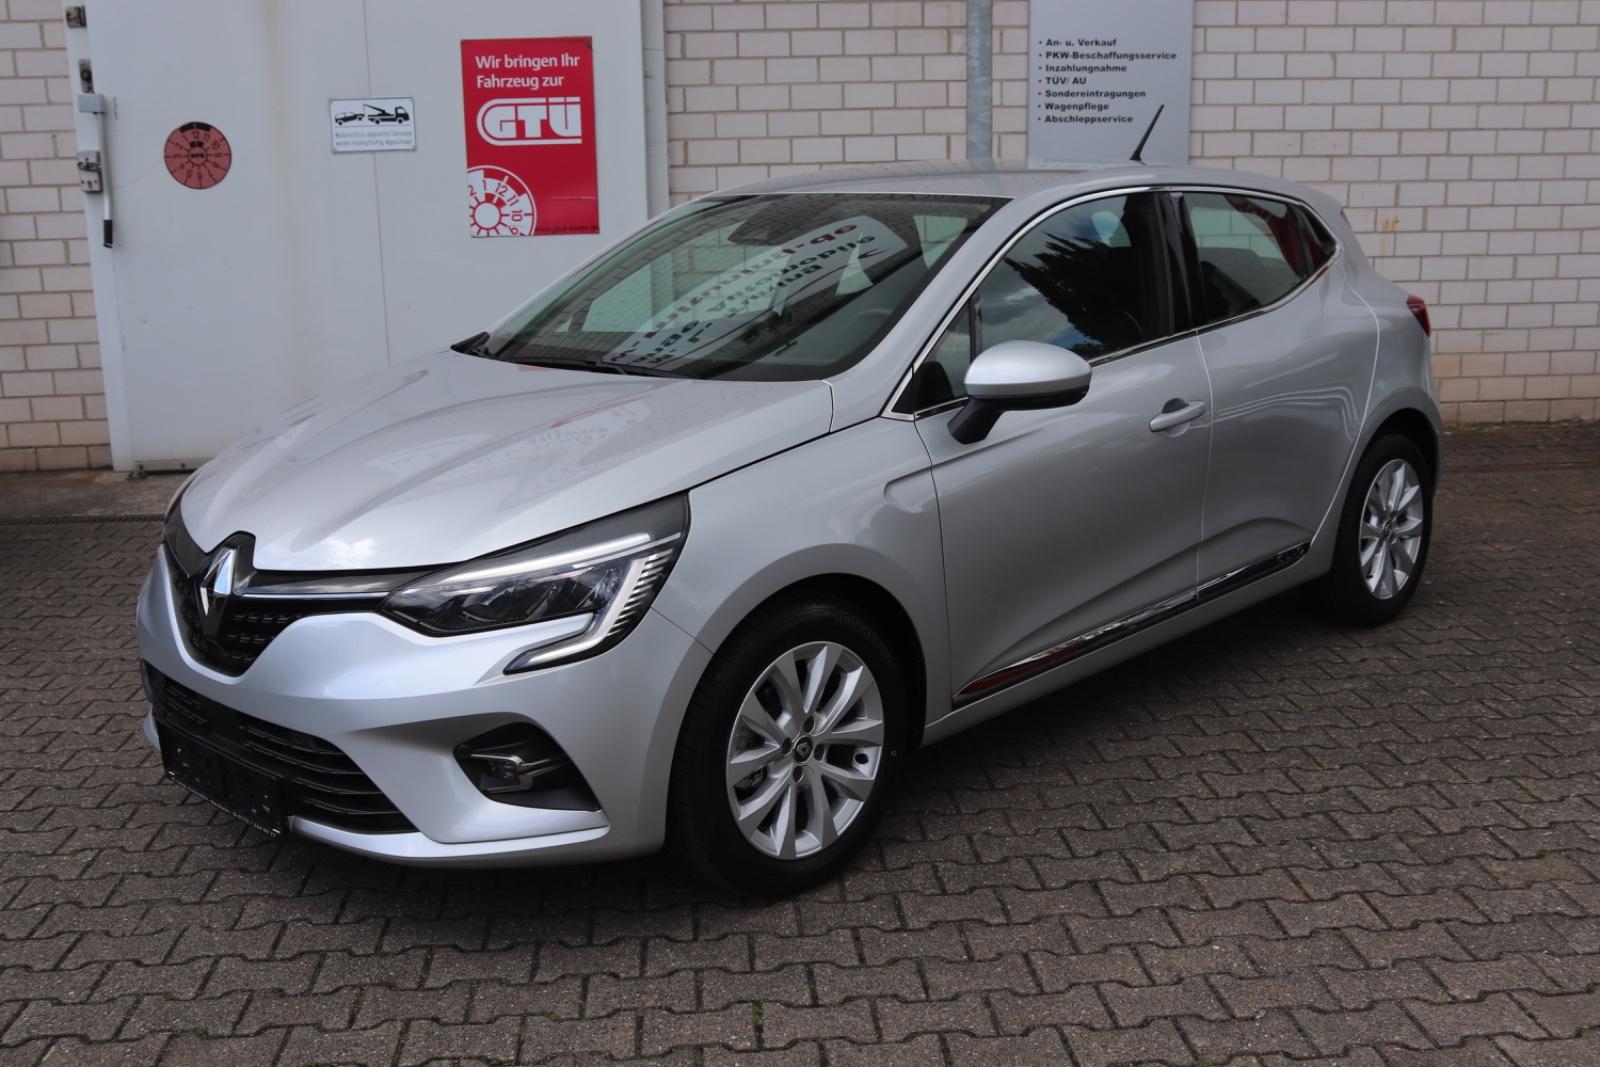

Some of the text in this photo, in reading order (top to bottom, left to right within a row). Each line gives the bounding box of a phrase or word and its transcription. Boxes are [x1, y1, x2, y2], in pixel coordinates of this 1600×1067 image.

[1046, 39, 1063, 47] An-
[1077, 38, 1117, 47] Verkauf
[1045, 51, 1177, 61] PKW-Beschaffungsservice
[475, 53, 580, 71] Wir bringen Ihr
[1045, 64, 1128, 74] Inzahlungnahme
[476, 74, 565, 90] Fahrzeug zur
[1072, 77, 1087, 85] AU
[1045, 89, 1146, 99] Sondereintragungen
[1045, 102, 1110, 112] Wagenpflege
[477, 97, 582, 146] GTÜ
[1044, 115, 1134, 125] Abschleppservice
[495, 182, 508, 197] 12
